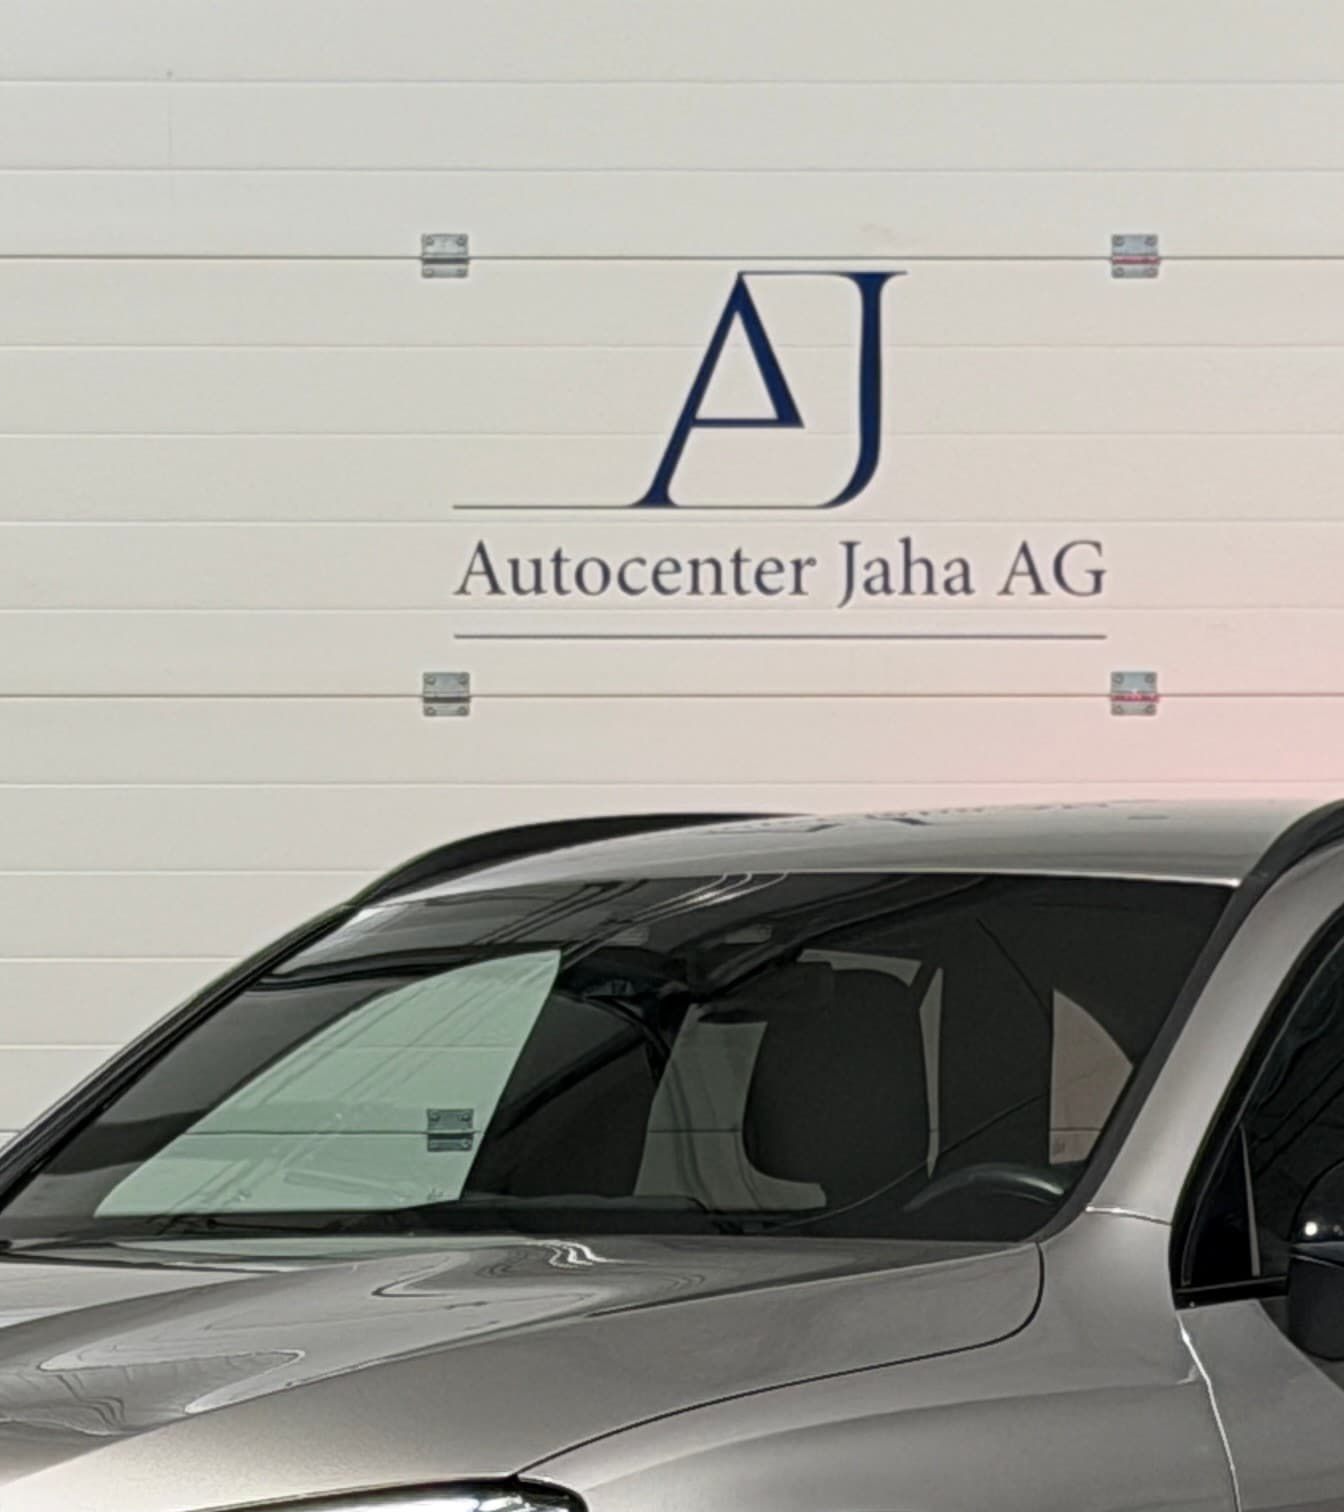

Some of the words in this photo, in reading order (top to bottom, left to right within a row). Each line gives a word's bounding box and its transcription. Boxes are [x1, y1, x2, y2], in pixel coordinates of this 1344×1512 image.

[626, 269, 909, 510] AJ
[452, 538, 817, 598] Autocenter
[836, 536, 975, 610] Jaha
[996, 538, 1108, 598] AG
